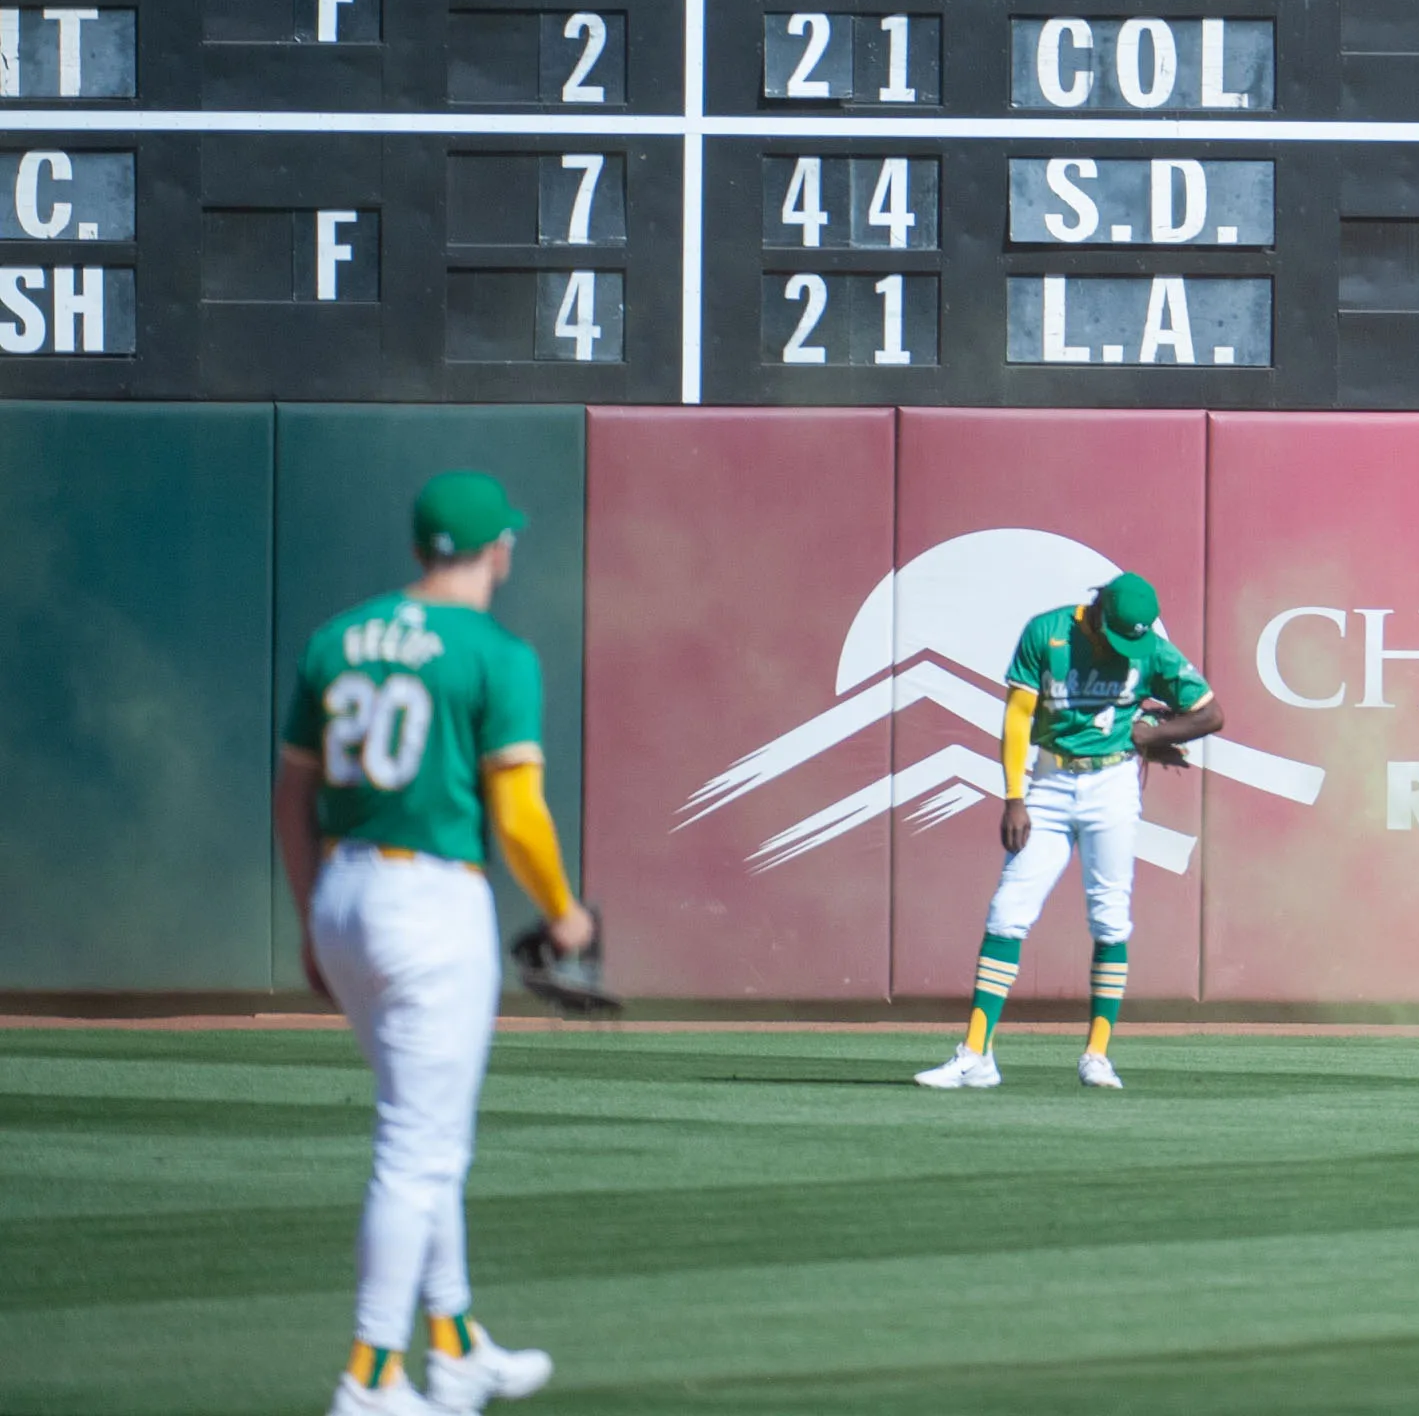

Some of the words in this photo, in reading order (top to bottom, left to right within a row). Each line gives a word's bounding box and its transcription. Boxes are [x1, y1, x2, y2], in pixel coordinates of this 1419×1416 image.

[562, 13, 606, 103] 2
[1036, 19, 1249, 109] COL
[561, 155, 604, 245] 7
[1043, 158, 1239, 244] S.D.
[317, 210, 357, 300] F
[554, 271, 601, 361] 4
[1043, 276, 1235, 365] L.A.
[322, 671, 434, 792] 20
